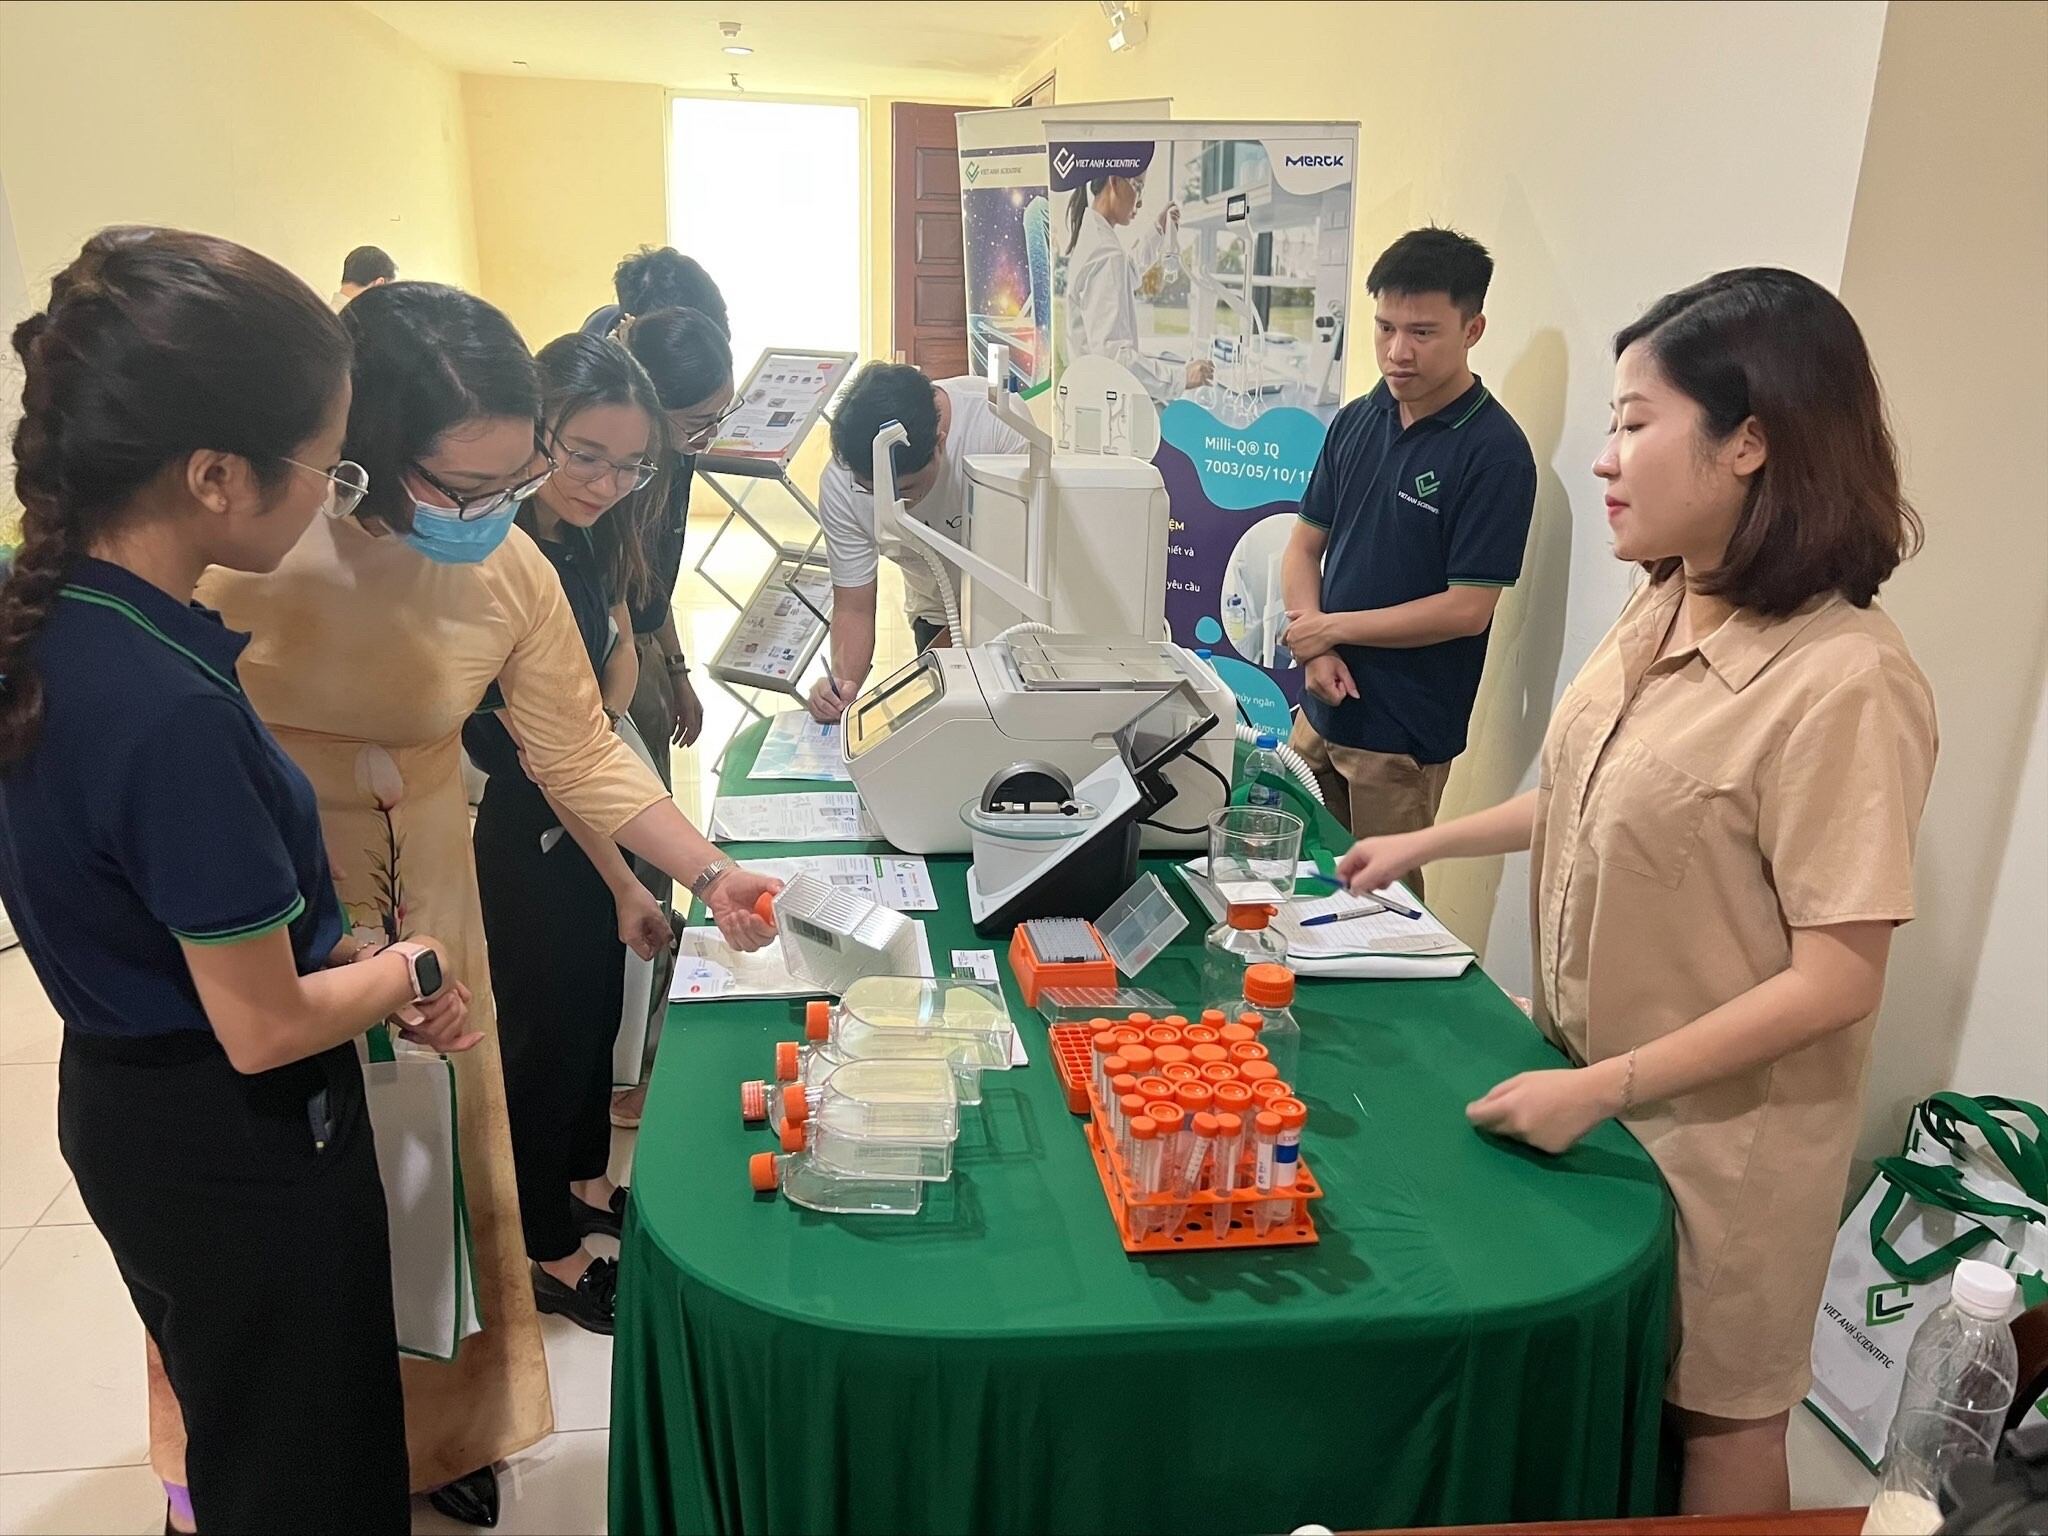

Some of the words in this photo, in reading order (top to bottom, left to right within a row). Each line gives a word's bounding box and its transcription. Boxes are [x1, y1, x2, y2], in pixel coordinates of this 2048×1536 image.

[1075, 159, 1090, 168] VIET
[1089, 159, 1105, 168] ANH
[1105, 159, 1141, 168] SCIENTIFIC
[1285, 155, 1344, 167] MERCK
[1263, 442, 1280, 459] IQ
[1168, 518, 1185, 531] ỆM
[1184, 547, 1195, 557] và
[1166, 579, 1183, 590] yêu
[1184, 581, 1201, 592] cầu
[1253, 697, 1275, 708] ngân
[1823, 1302, 1842, 1320] VIET
[1837, 1318, 1858, 1335] ANH
[1852, 1331, 1895, 1369] SCIENTIFIC
